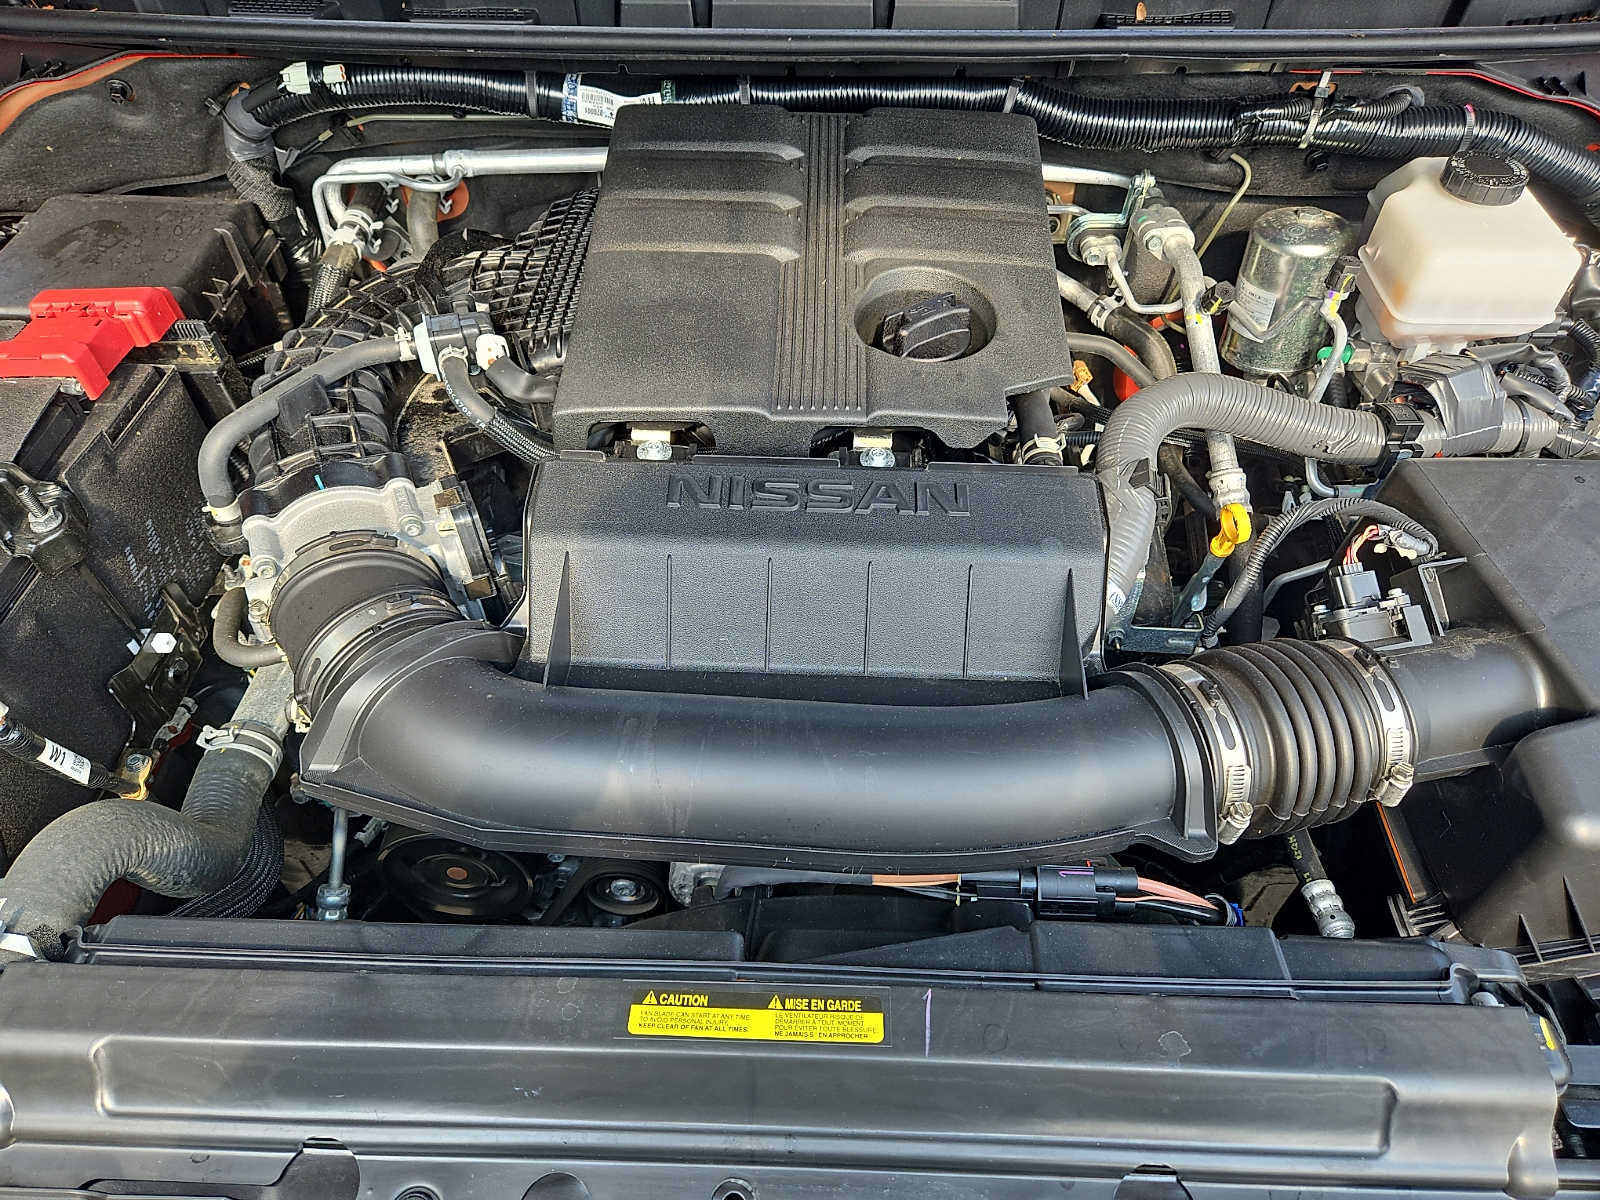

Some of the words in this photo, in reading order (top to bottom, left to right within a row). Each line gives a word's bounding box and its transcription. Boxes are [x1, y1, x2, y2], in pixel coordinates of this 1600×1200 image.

[666, 473, 970, 516] NISSAN
[49, 744, 66, 766] W1
[659, 993, 708, 1006] CAUTION
[785, 998, 809, 1010] MISE
[811, 999, 824, 1010] EN
[827, 999, 861, 1011] GARDE
